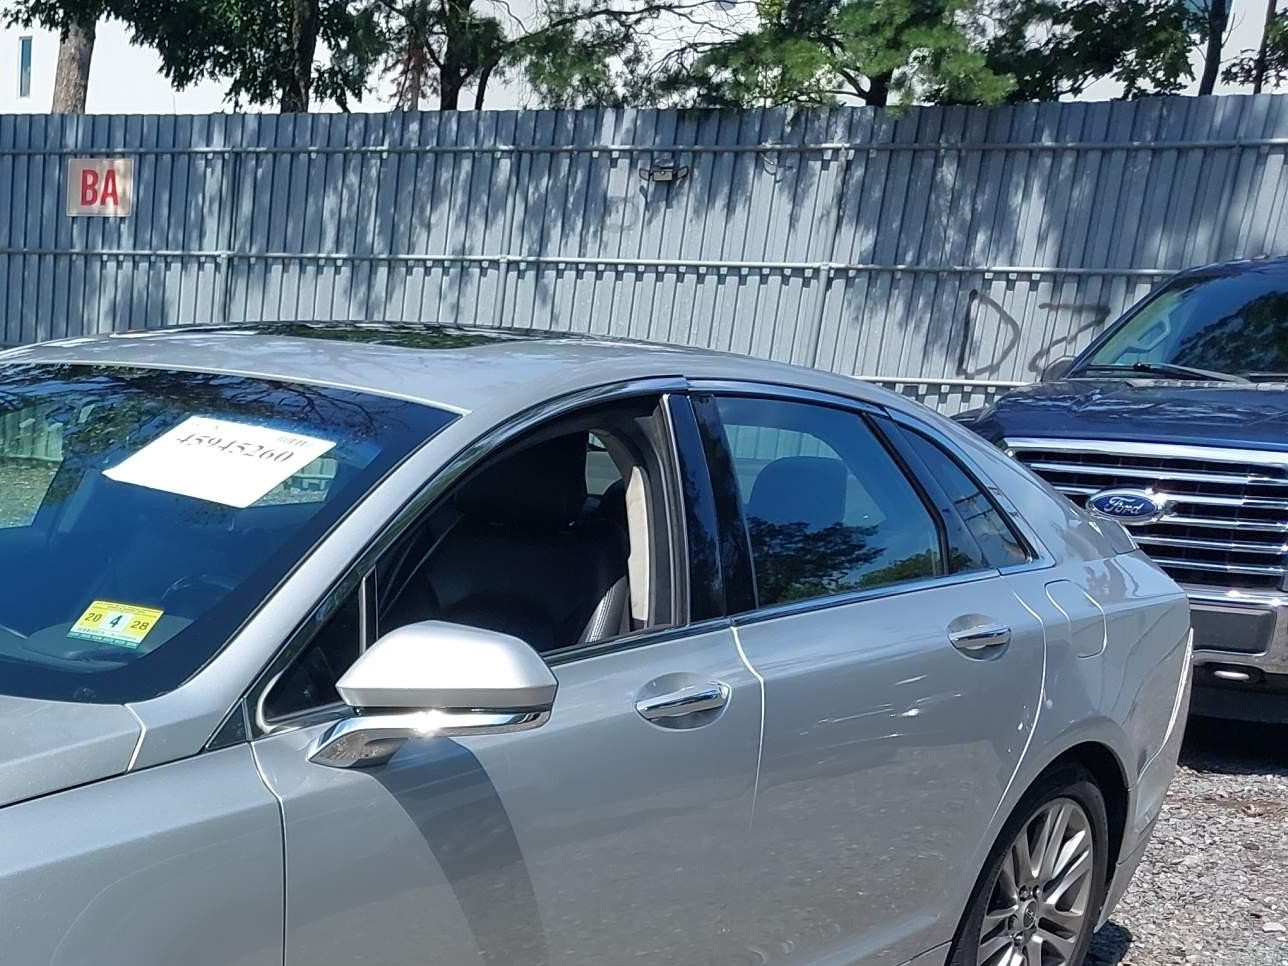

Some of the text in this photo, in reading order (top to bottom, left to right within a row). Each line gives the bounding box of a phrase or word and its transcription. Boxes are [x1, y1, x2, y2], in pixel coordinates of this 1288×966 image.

[80, 169, 119, 206] BA
[176, 432, 295, 463] 45945260
[1104, 496, 1144, 514] Ford
[84, 612, 150, 631] 20 4 28
